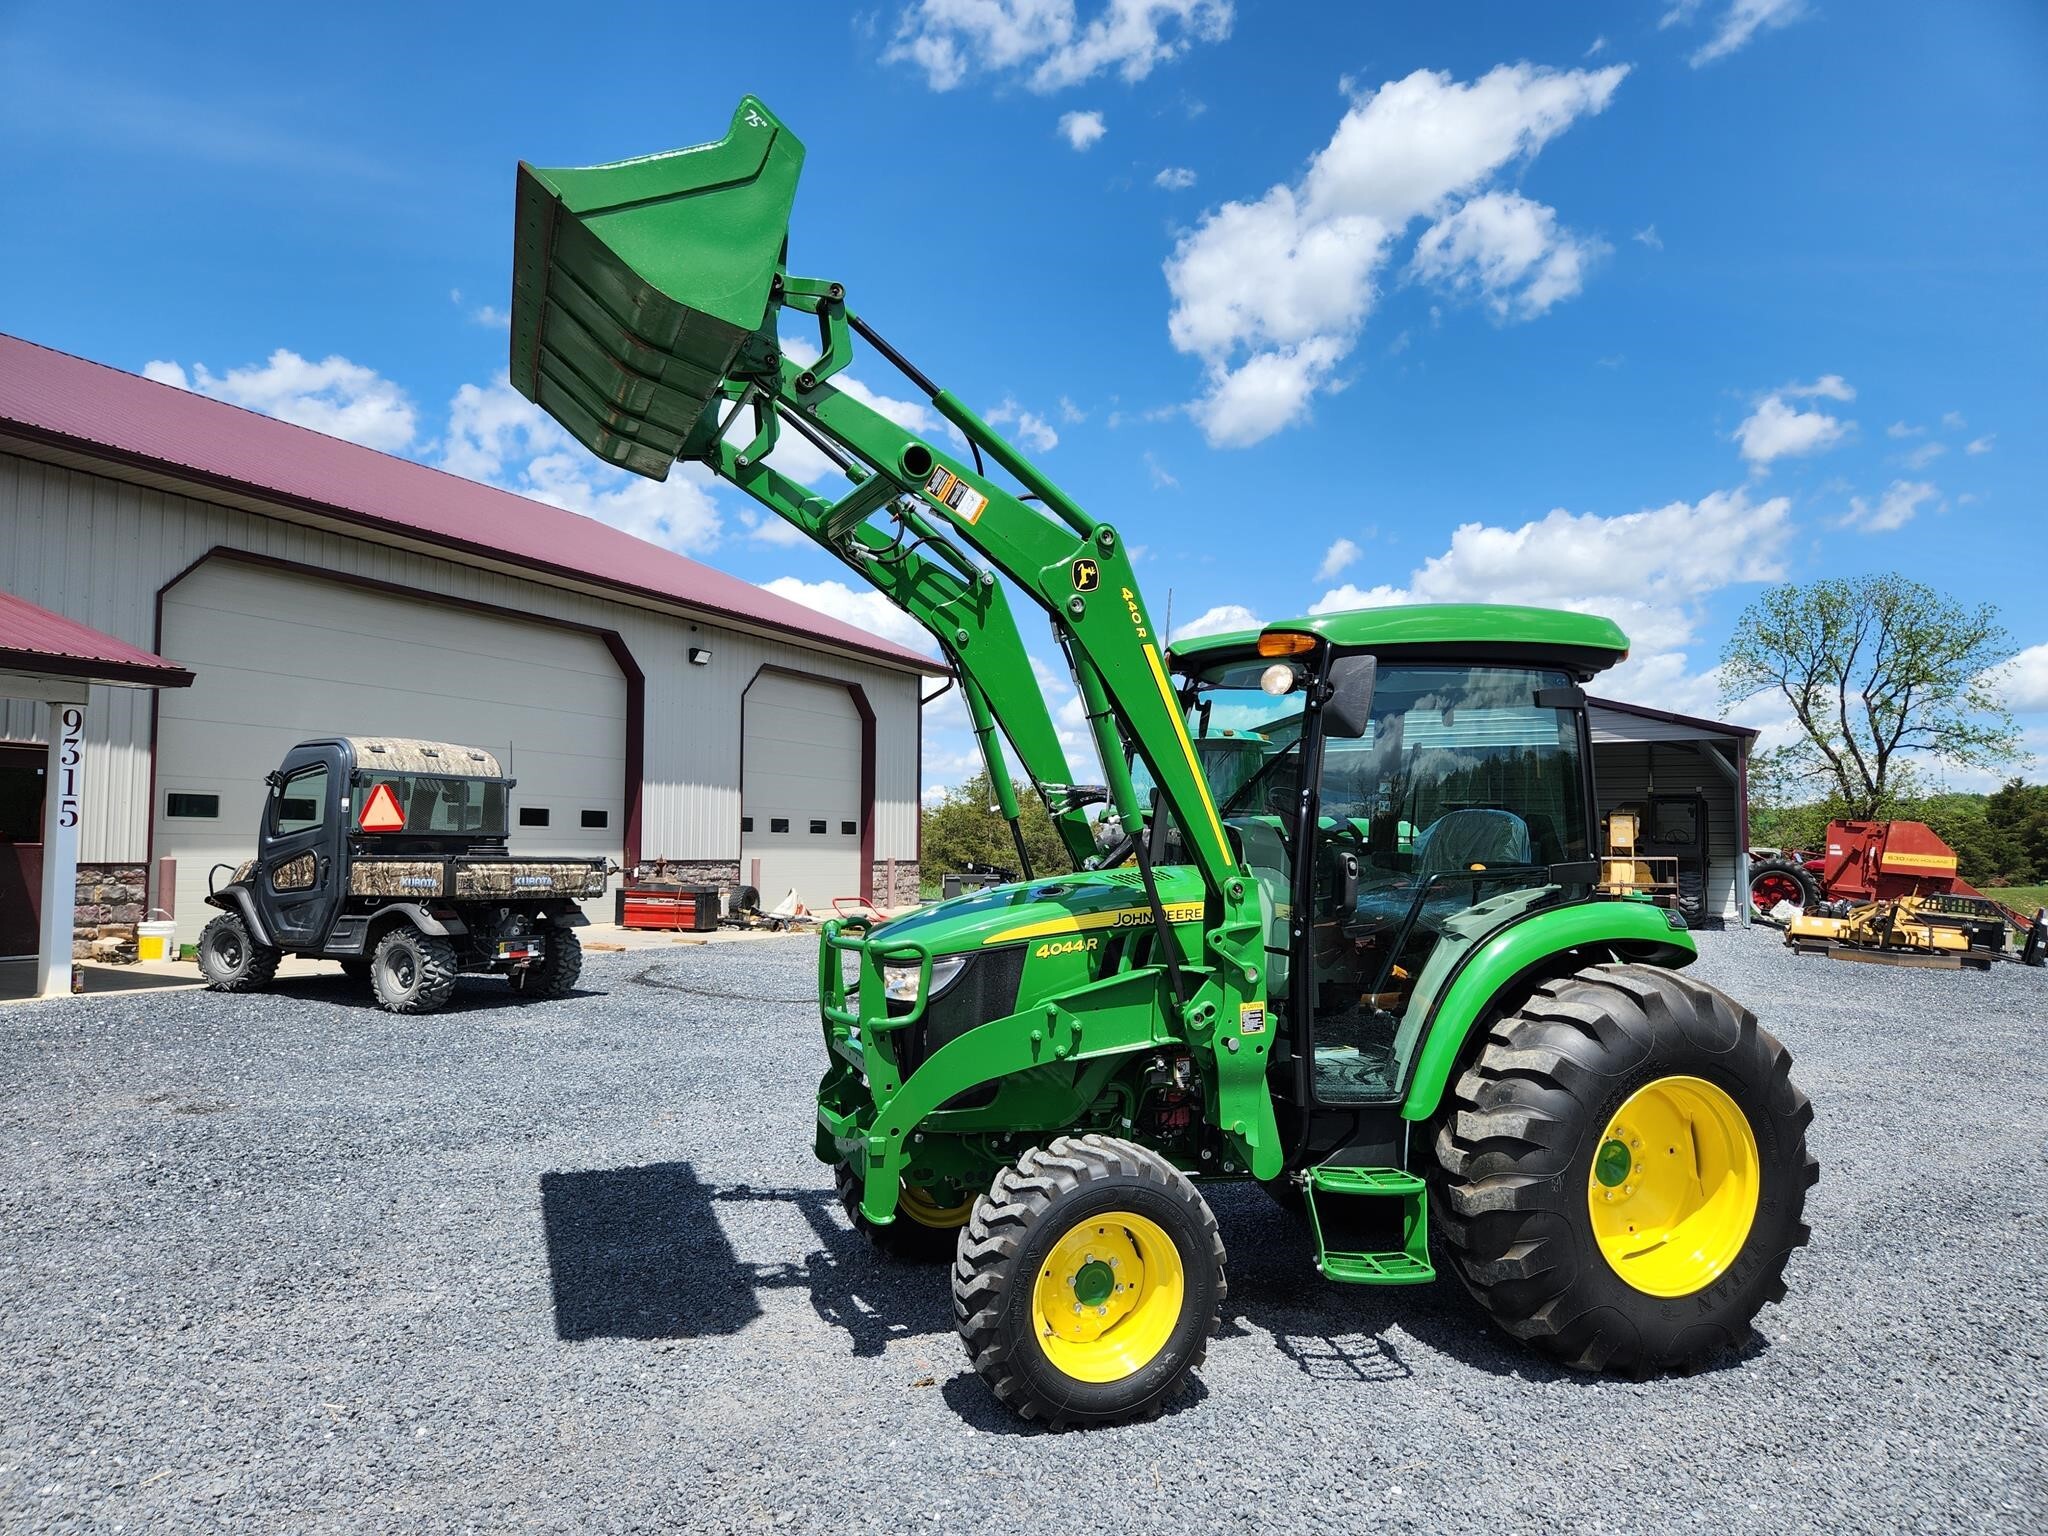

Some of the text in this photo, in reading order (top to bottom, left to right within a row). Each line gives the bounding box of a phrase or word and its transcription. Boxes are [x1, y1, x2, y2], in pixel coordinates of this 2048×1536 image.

[60, 709, 82, 827] 9315
[402, 877, 437, 888] KUBOTA
[514, 876, 554, 887] KUBOTA
[1113, 912, 1153, 927] JOHN
